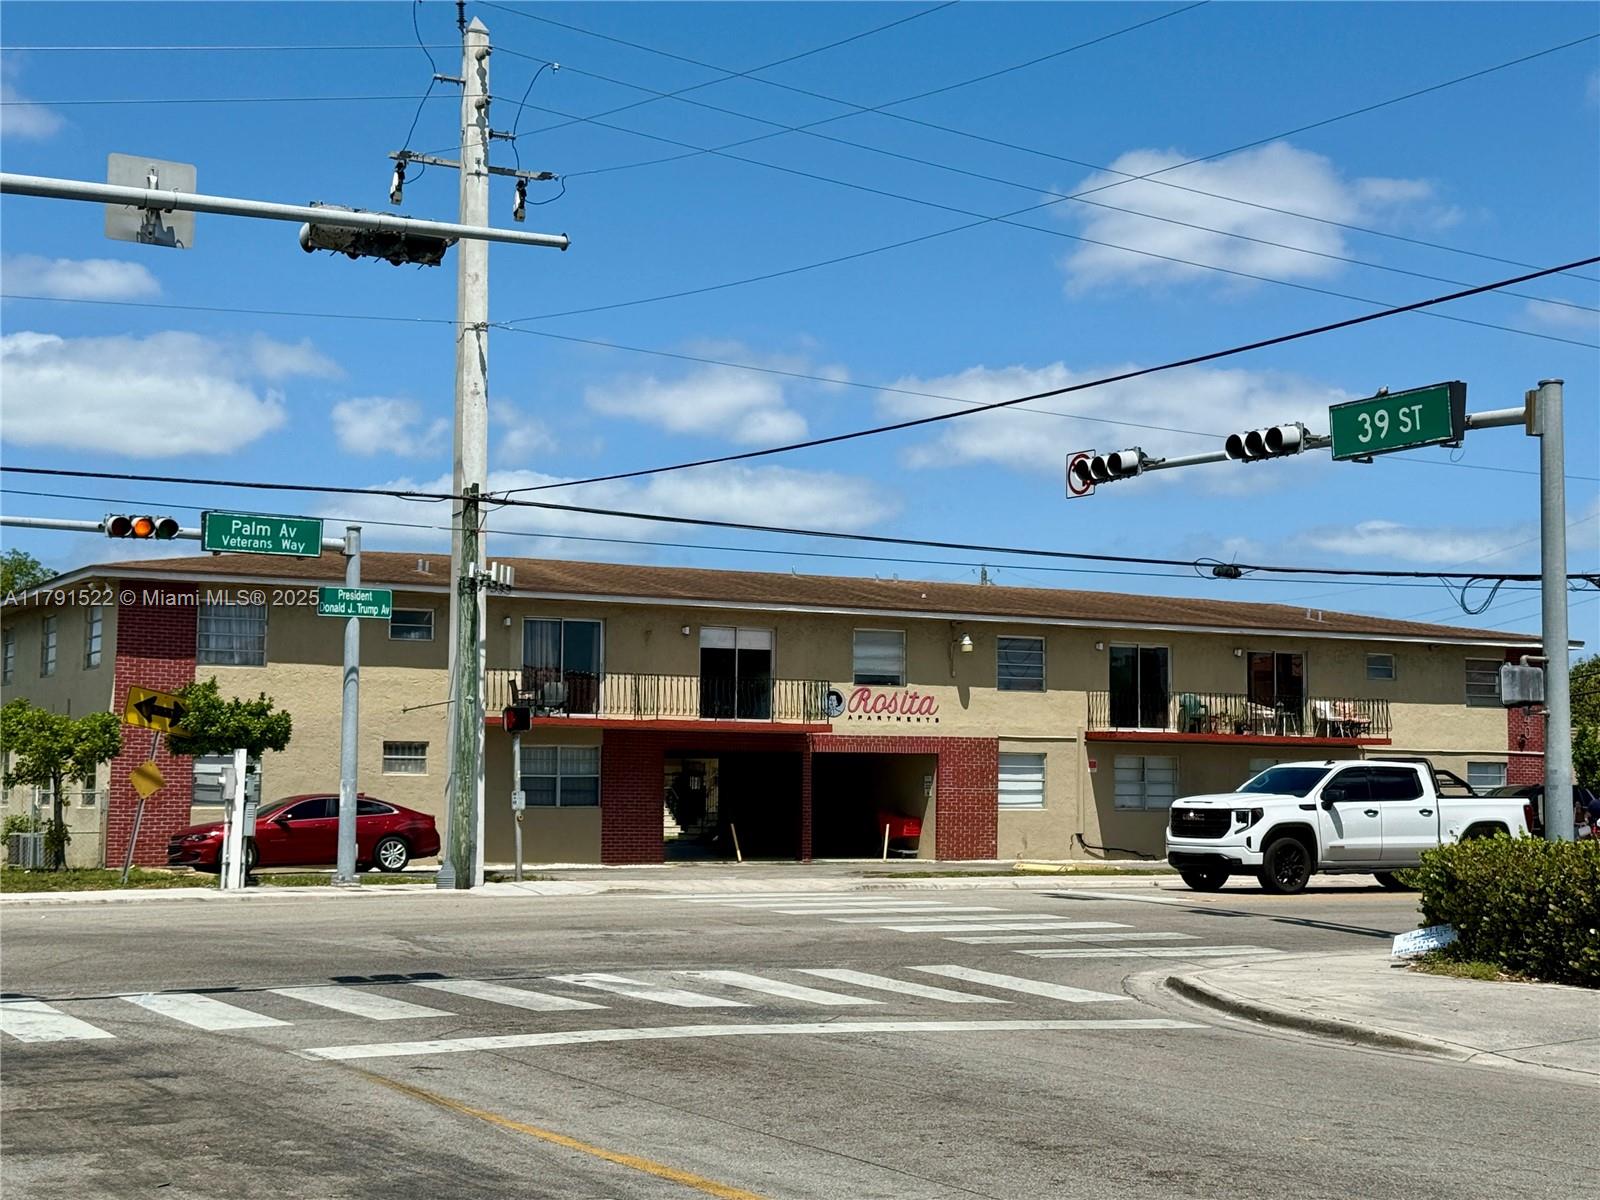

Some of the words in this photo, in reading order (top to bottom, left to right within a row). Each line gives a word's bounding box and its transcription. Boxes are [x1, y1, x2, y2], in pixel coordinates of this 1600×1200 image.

[1358, 409, 1390, 443] 39
[1399, 404, 1423, 433] ST
[231, 520, 271, 537] Palm
[279, 523, 297, 538] Av
[221, 535, 273, 549] Veterans
[281, 540, 306, 553] Way
[338, 589, 373, 601] President
[320, 602, 345, 613] Donald
[356, 603, 379, 616] Trump
[381, 604, 390, 615] Av
[848, 687, 940, 715] Rosita
[848, 714, 939, 723] APARTMENTS
